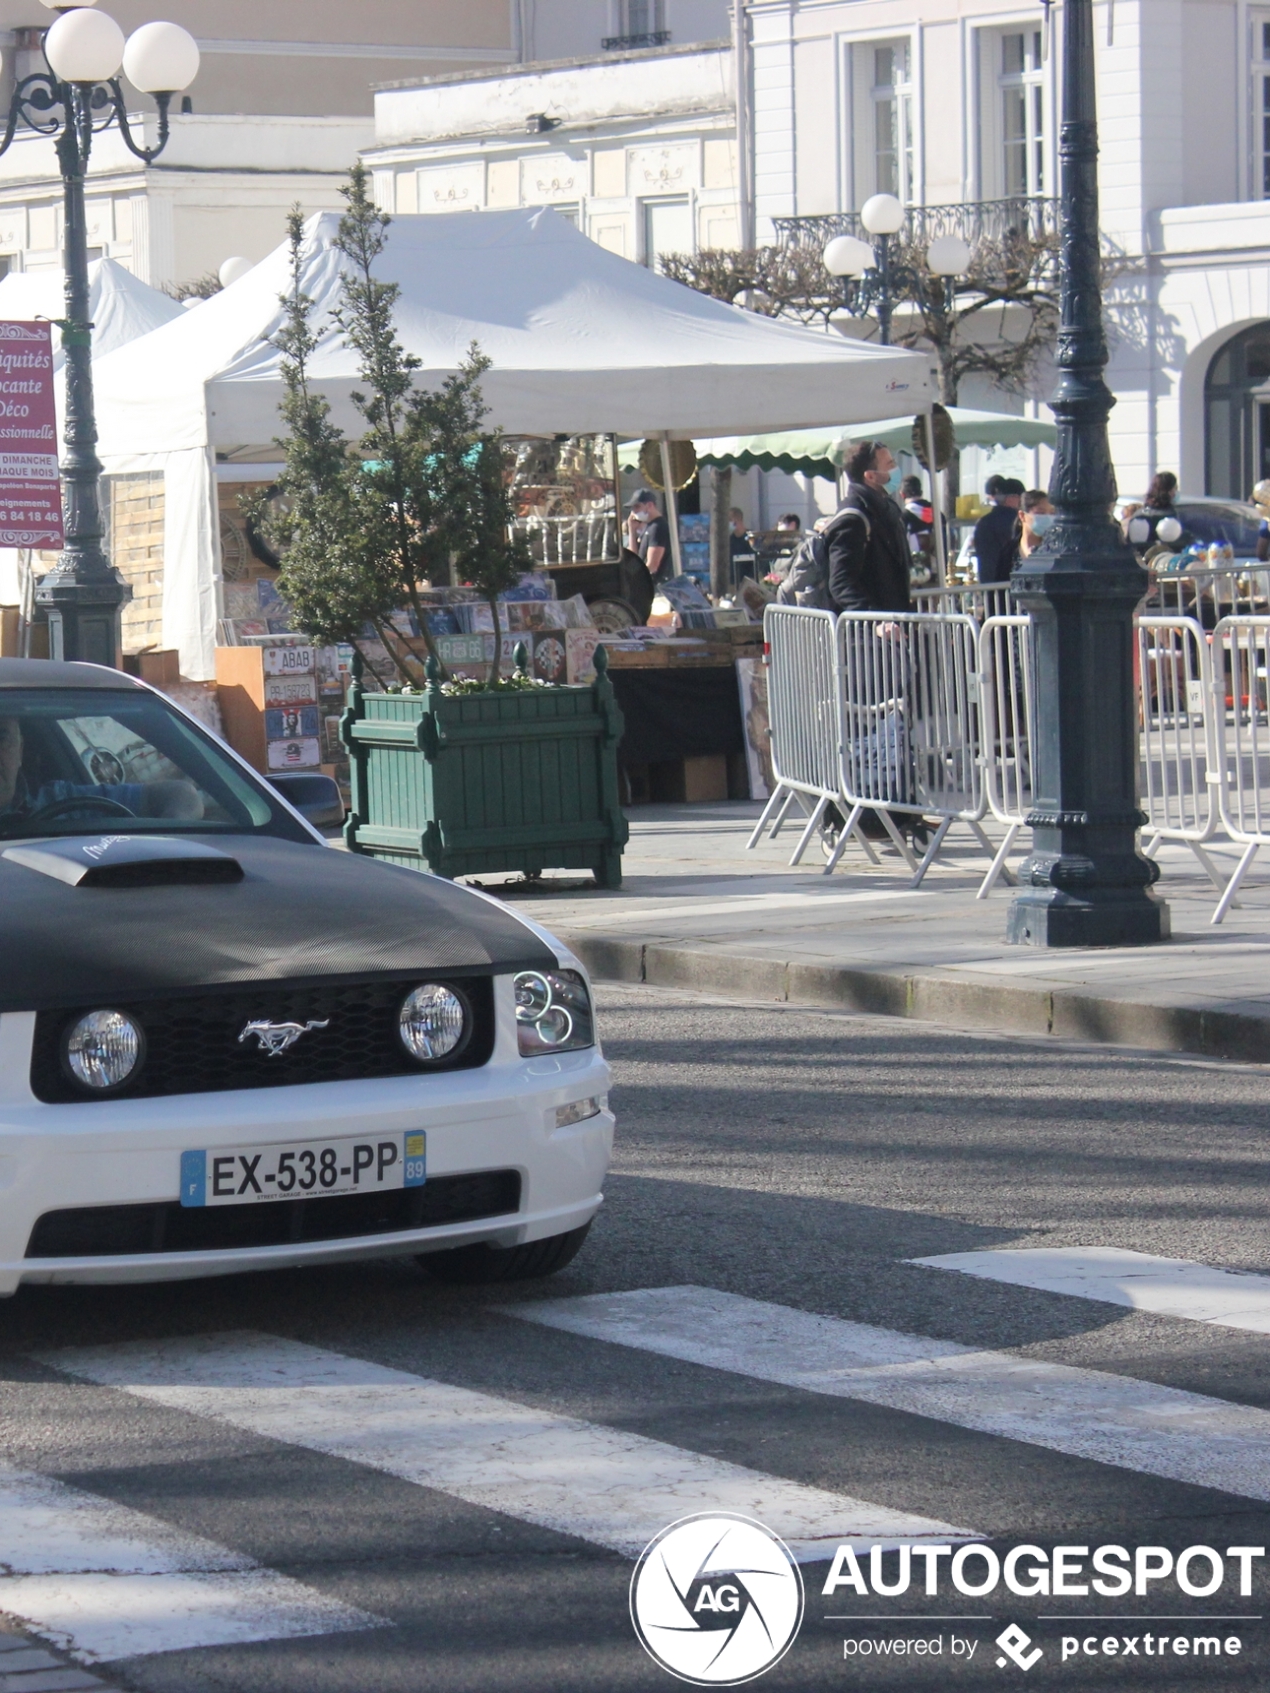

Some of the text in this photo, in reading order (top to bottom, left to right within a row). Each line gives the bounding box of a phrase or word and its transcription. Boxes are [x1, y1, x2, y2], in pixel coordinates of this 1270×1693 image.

[2, 455, 52, 465] DIMANCHE
[31, 468, 54, 477] MOIS
[10, 511, 24, 521] 84
[28, 512, 41, 521] 18
[44, 512, 59, 522] 46
[282, 651, 310, 668] ABAB
[212, 1141, 398, 1197] EX-538-PP
[406, 1161, 424, 1179] 89
[189, 1184, 196, 1195] F
[278, 1191, 301, 1199] GARAGE
